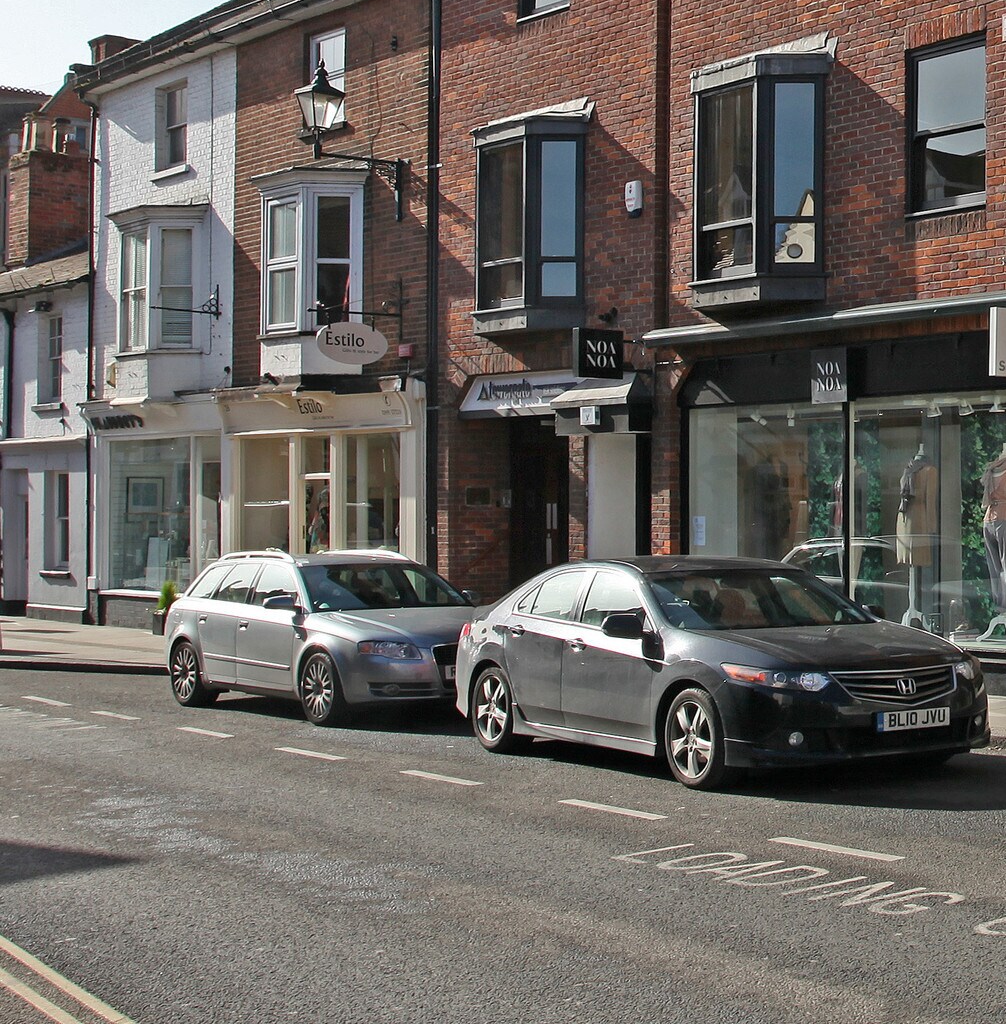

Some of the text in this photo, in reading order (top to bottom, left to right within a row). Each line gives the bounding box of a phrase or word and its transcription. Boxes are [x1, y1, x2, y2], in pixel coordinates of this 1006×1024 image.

[325, 331, 365, 347] Estilo
[586, 340, 616, 354] NOA
[586, 354, 616, 368] NOA
[817, 362, 841, 375] NOA
[817, 376, 842, 391] NOA
[296, 399, 323, 414] Estilo
[888, 709, 946, 728] BL10 JVU
[610, 843, 966, 915] LOADING
